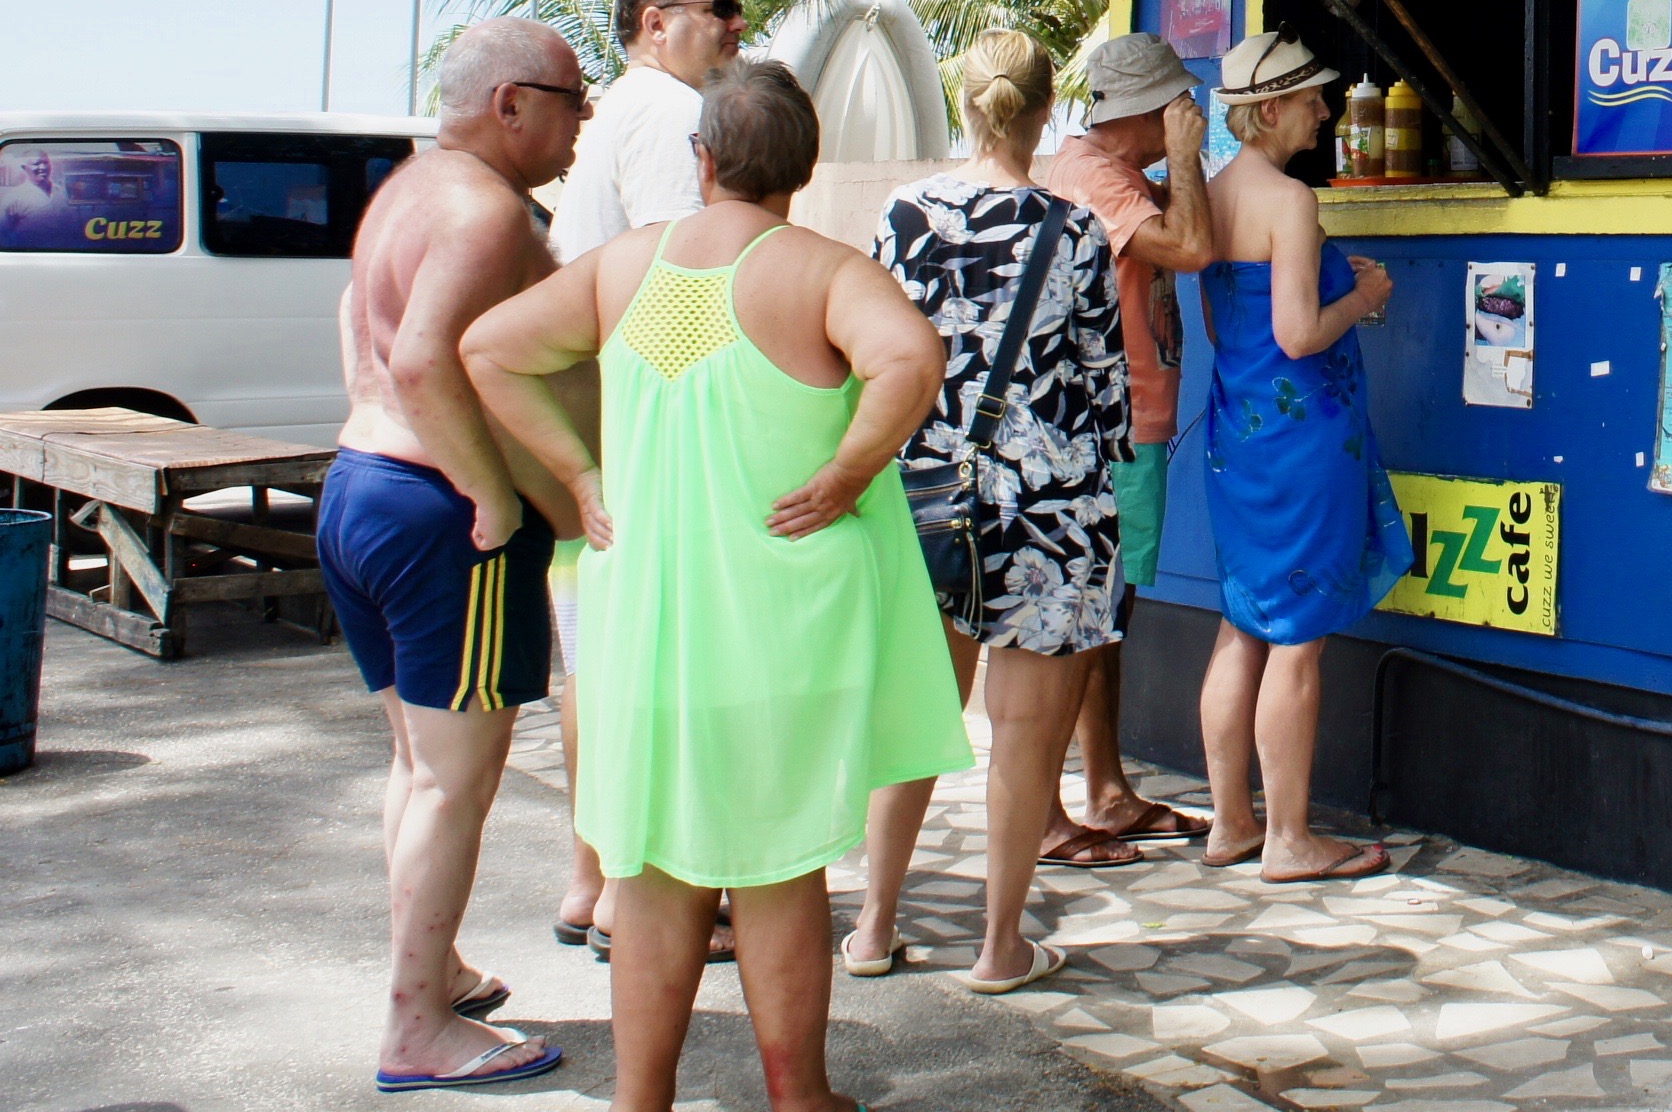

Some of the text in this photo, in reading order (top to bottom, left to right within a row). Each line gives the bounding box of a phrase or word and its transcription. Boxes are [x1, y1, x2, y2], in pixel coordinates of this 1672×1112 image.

[84, 217, 163, 240] Cuzz
[1500, 491, 1532, 615] cafe
[1544, 553, 1554, 579] we
[1542, 585, 1551, 627] cuzz
